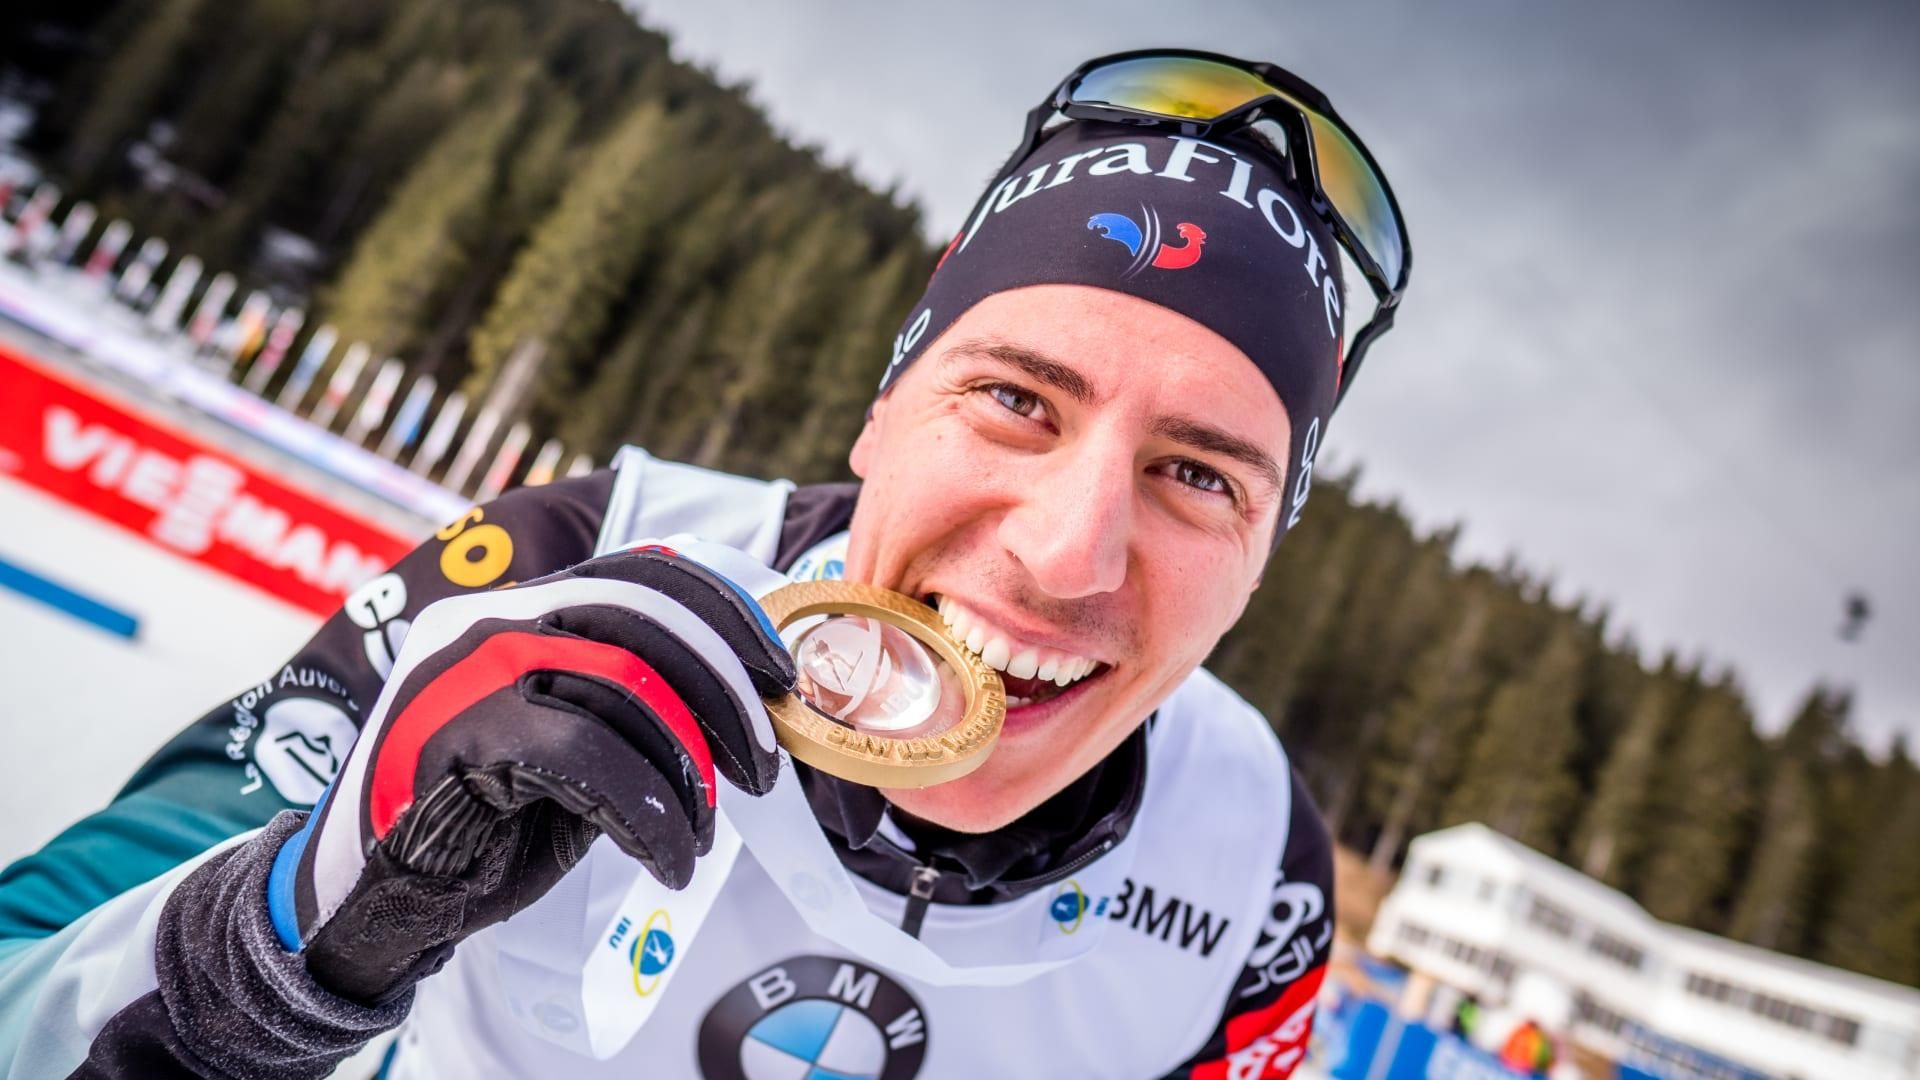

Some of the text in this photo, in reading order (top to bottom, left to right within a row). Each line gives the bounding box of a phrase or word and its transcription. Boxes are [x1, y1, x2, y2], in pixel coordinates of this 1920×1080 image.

[42, 404, 389, 598] VIESSMAN
[608, 915, 632, 950] IBU
[748, 963, 926, 1051] BMW
